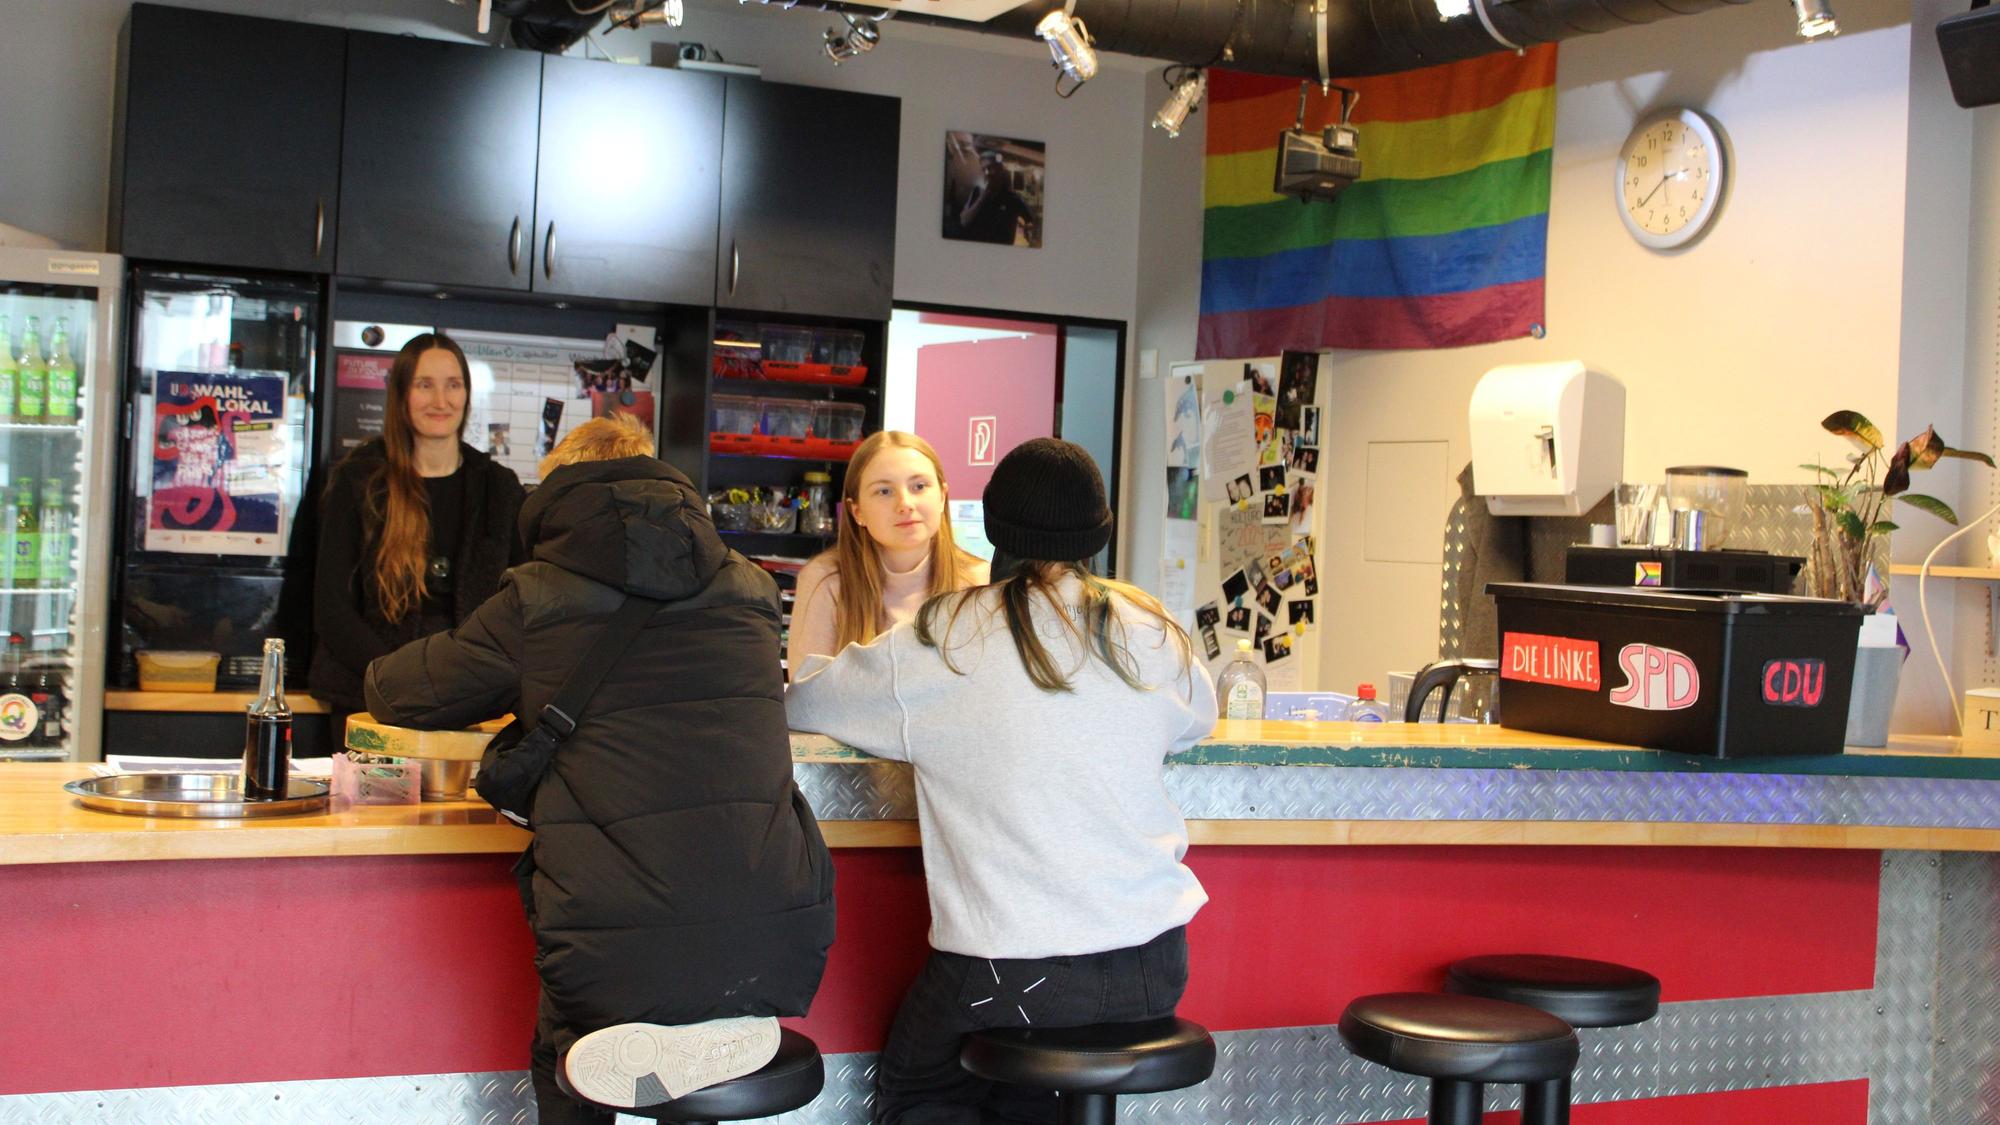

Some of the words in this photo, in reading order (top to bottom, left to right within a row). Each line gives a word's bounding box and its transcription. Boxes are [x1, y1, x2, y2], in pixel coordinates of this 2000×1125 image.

[1663, 130, 1673, 142] 12
[1648, 139, 1657, 151] 11
[1637, 156, 1648, 167] 10
[1697, 167, 1703, 178] 3
[1633, 177, 1640, 187] 9
[1692, 190, 1698, 200] 4
[1649, 210, 1655, 221] 7
[1680, 206, 1686, 217] 5
[1664, 215, 1670, 225] 6
[216, 399, 273, 414] LOKAL
[1513, 644, 1538, 677] DIE
[1610, 645, 1698, 708] SPD
[1765, 661, 1824, 705] CDU
[1979, 709, 2000, 731] T
